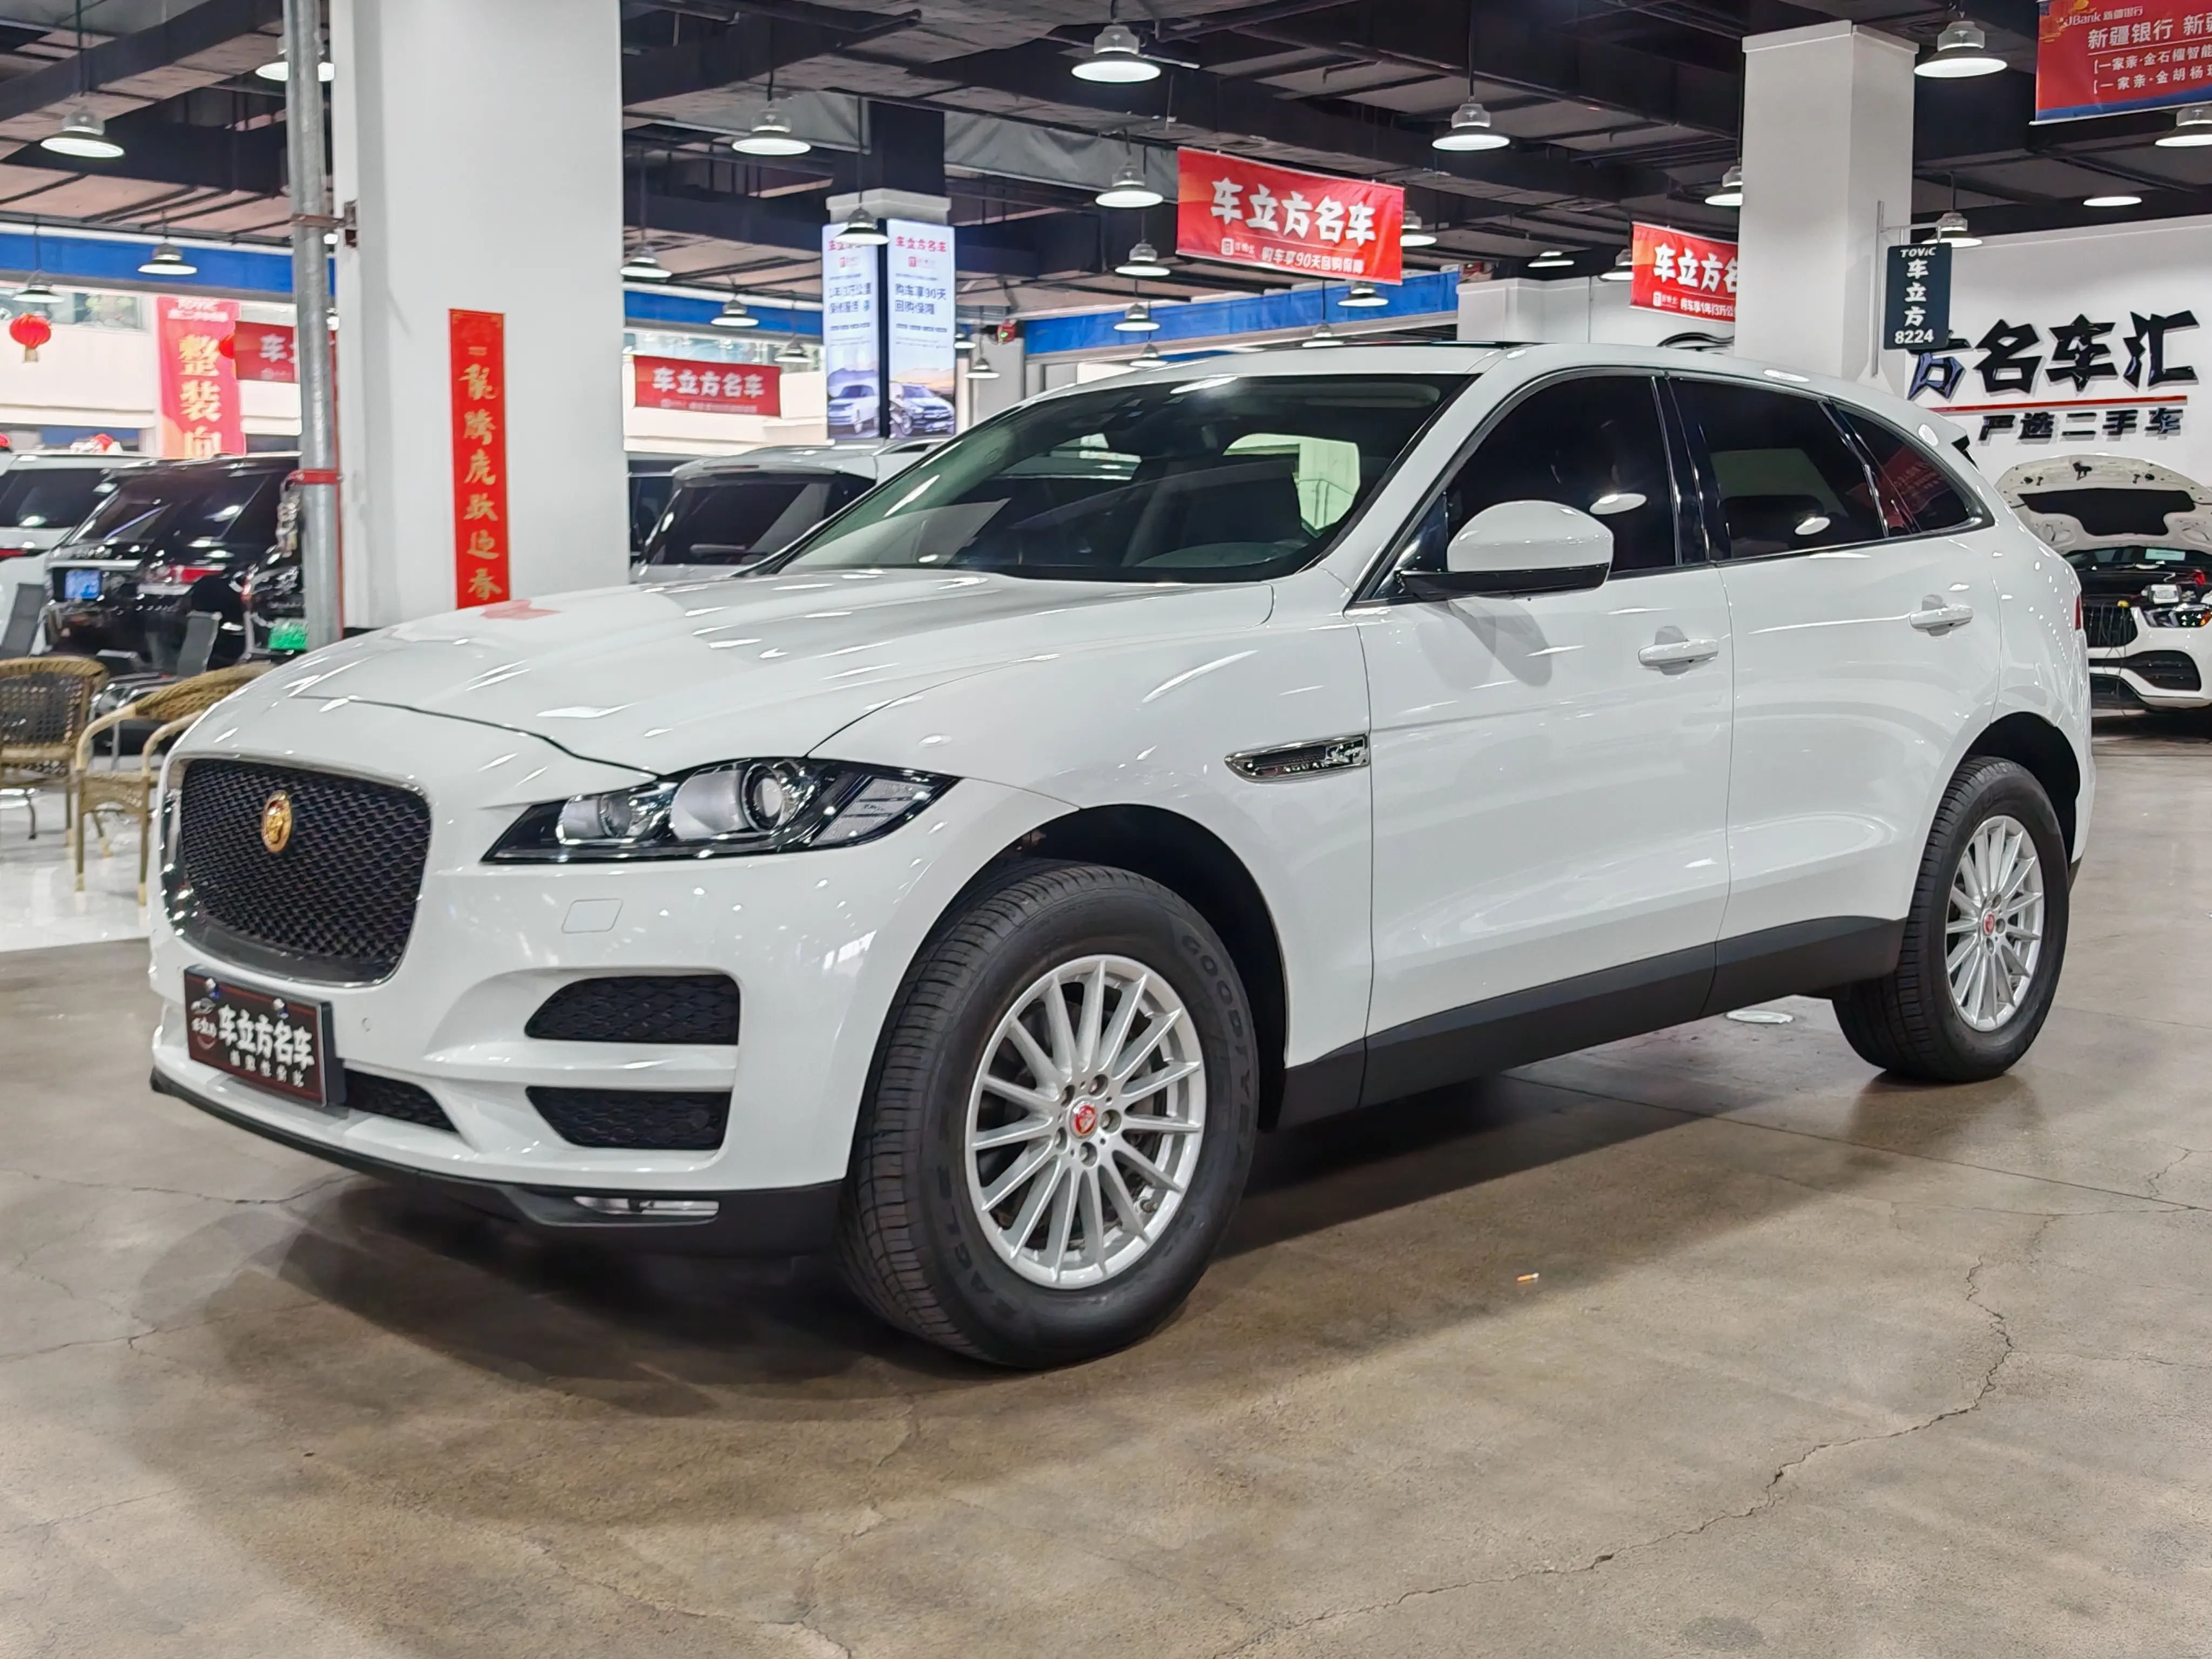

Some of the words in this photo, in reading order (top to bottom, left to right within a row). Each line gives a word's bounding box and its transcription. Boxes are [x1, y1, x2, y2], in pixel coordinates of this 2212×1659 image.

[2087, 18, 2174, 50] 新疆银行
[1210, 177, 1377, 246] 车立方名车
[895, 236, 947, 252] 车立方名车
[1904, 258, 1929, 327] 车立方
[259, 332, 295, 365] 车
[1894, 328, 1935, 345] 8224
[652, 366, 765, 399] 车立方名车
[218, 1003, 315, 1071] 车立方名车
